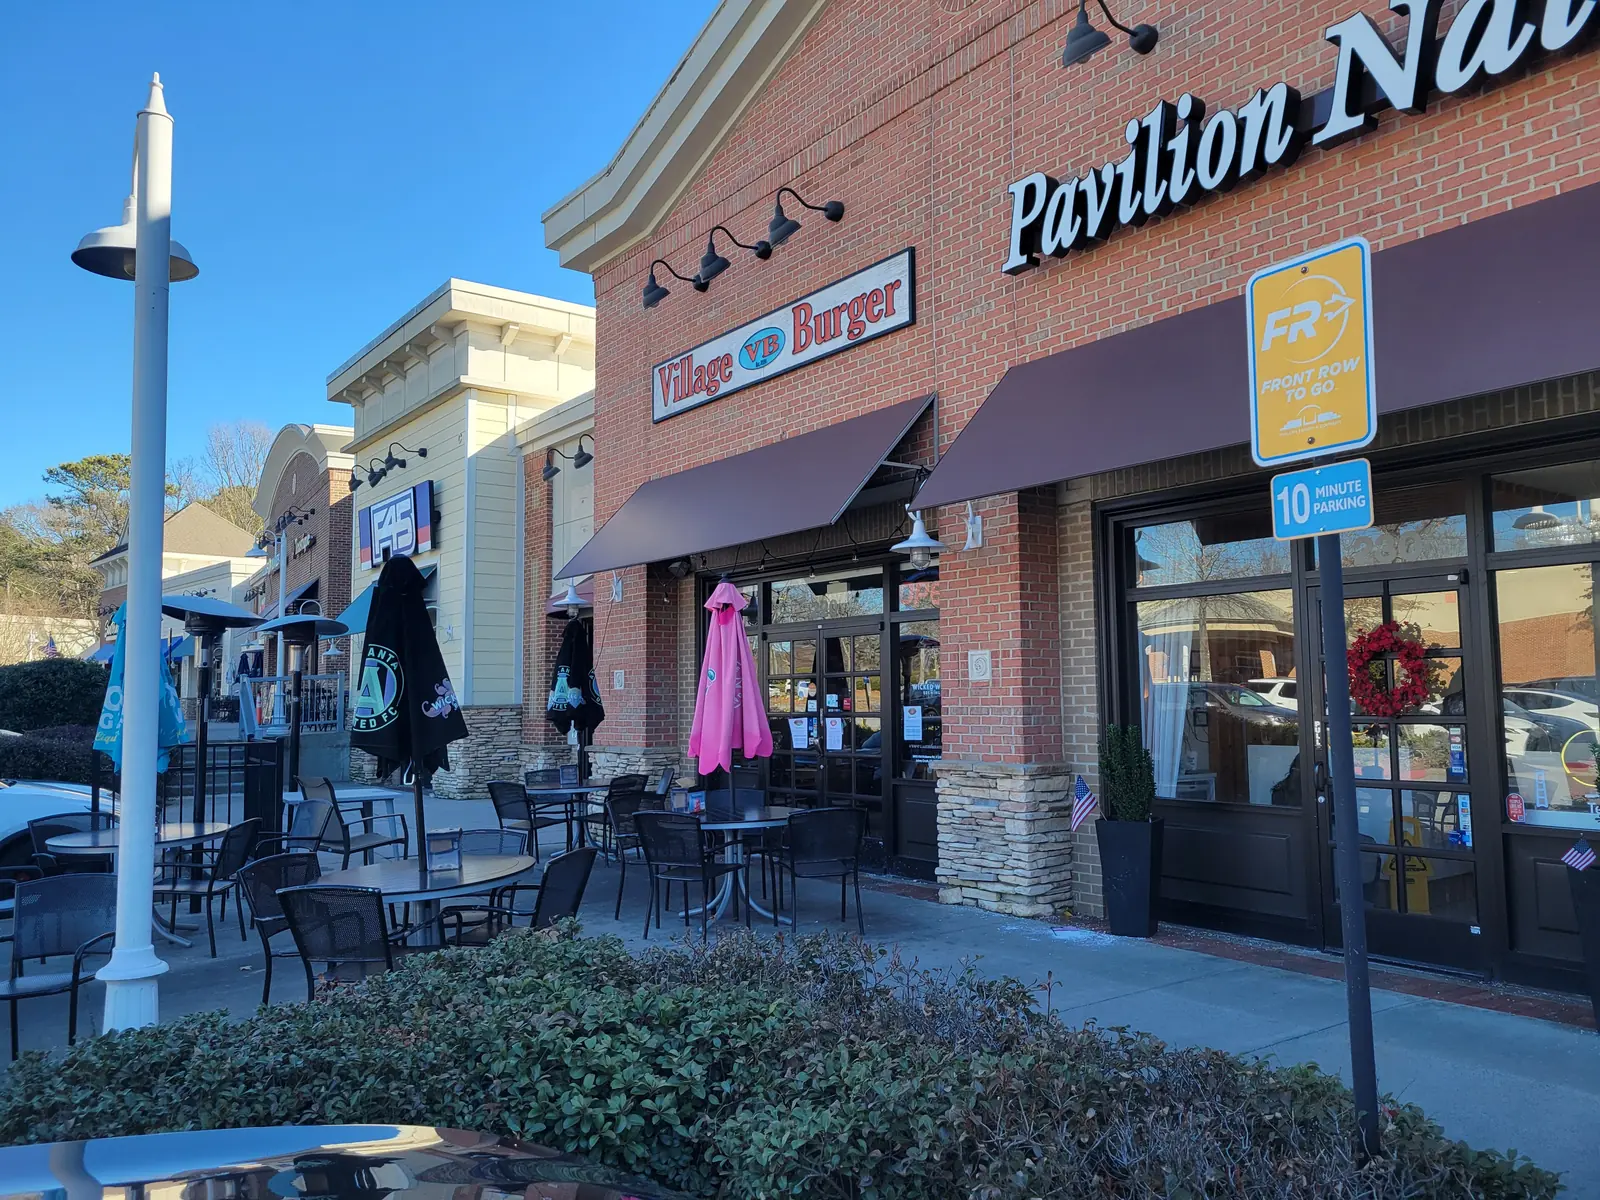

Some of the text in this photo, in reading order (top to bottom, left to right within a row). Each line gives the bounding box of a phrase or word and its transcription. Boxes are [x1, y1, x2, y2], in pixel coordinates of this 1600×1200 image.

[1001, 81, 1300, 275] Pavilion
[657, 278, 902, 408] Village VB Burger
[1261, 300, 1321, 352] FR
[1262, 356, 1361, 395] FRONT ROW
[1286, 379, 1335, 403] TO GO
[1276, 479, 1363, 526] 10 MINUTE
[1313, 495, 1366, 515] PARKING
[382, 706, 398, 722] FC
